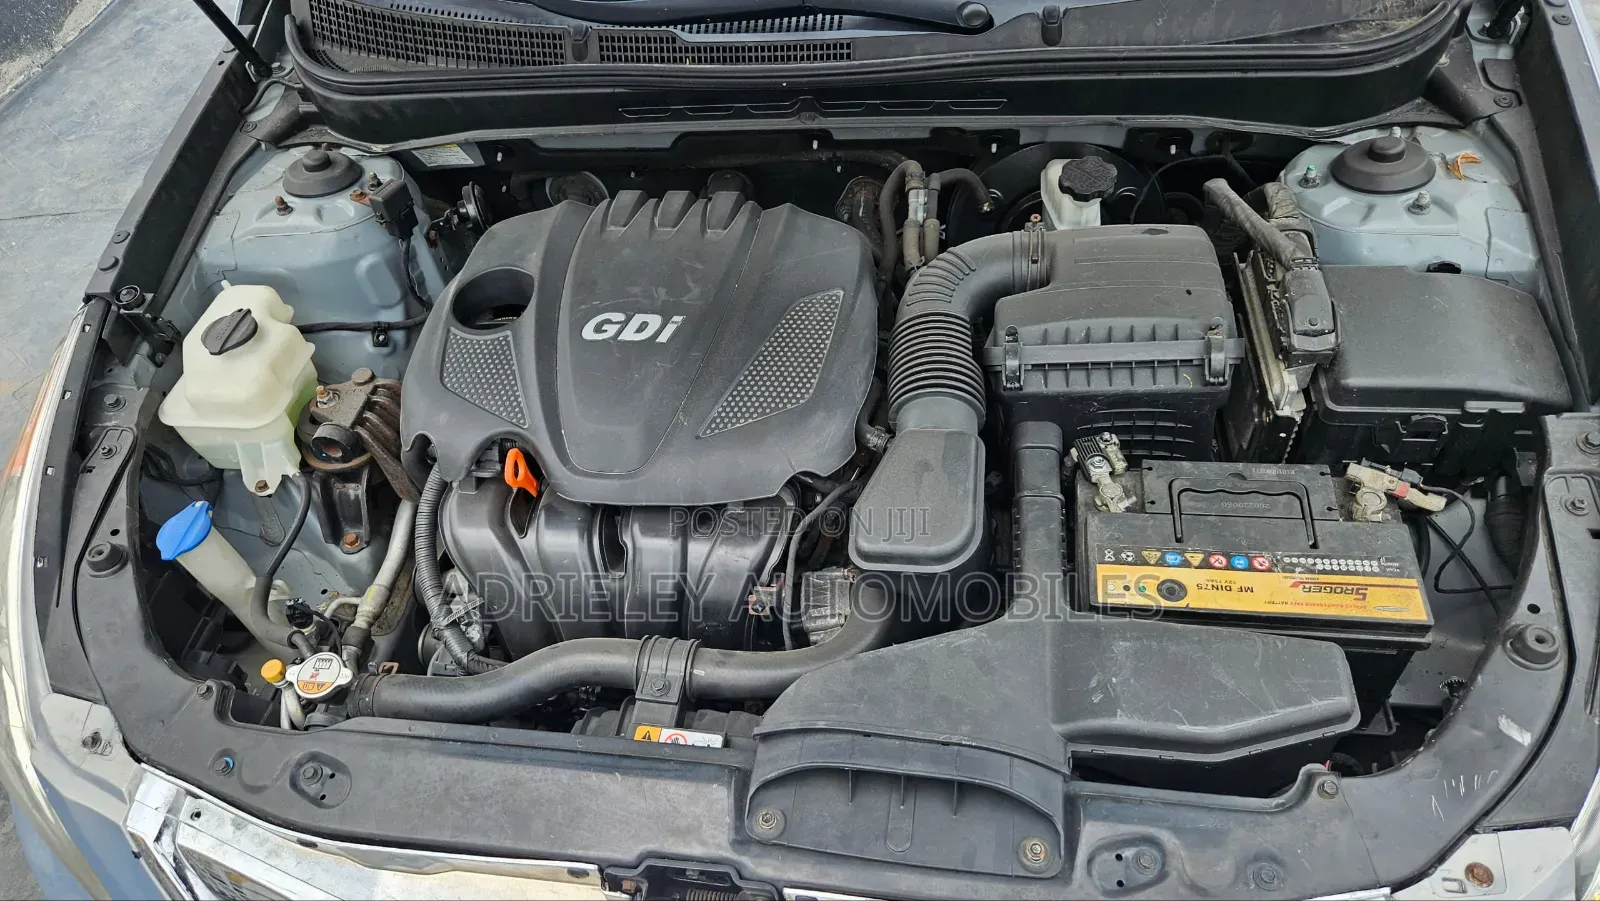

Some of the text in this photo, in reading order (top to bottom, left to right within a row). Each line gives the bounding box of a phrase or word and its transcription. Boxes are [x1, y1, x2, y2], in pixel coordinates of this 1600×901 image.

[581, 312, 687, 344] GDi
[1196, 583, 1254, 593] MF DIN75
